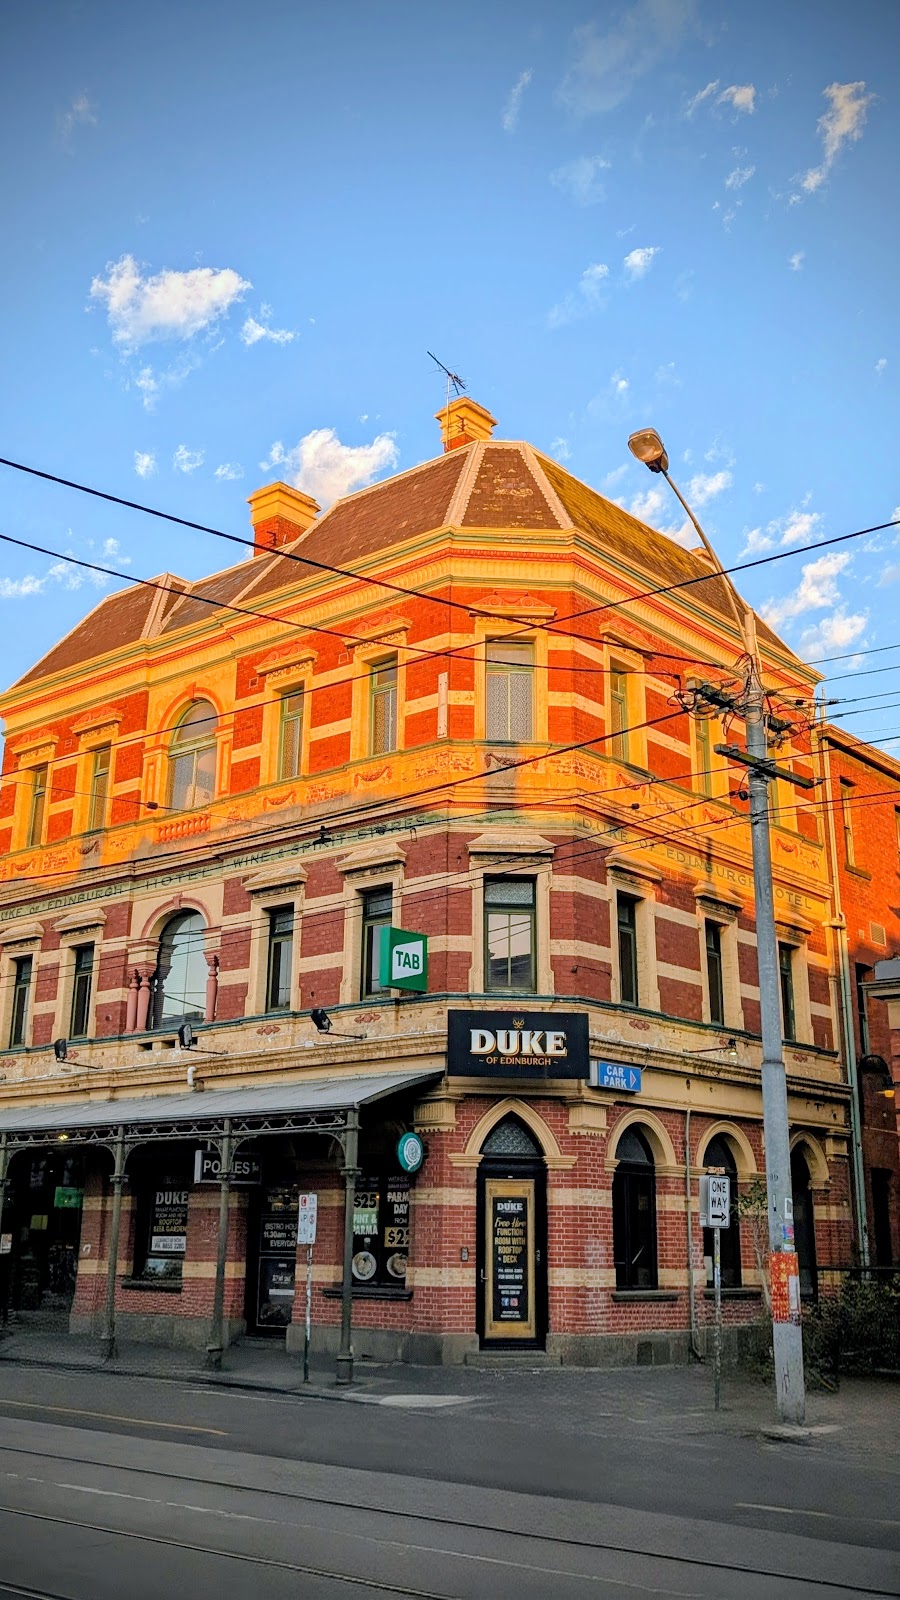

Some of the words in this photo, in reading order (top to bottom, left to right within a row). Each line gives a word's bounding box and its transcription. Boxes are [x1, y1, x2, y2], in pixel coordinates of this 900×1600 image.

[234, 849, 271, 868] WINE
[47, 885, 123, 910] EDINBURGH
[145, 868, 213, 890] HOTEL
[775, 887, 812, 910] OTEL
[395, 950, 420, 970] TAB
[469, 1028, 568, 1057] DUKE
[486, 1057, 498, 1065] OF
[500, 1057, 551, 1066] EDINBURGH
[606, 1065, 625, 1078] CAR
[603, 1076, 627, 1088] PARK
[712, 1181, 727, 1193] ONE
[155, 1191, 188, 1205] DUKE
[353, 1193, 377, 1208] $25
[387, 1192, 410, 1202] PARM
[711, 1197, 728, 1209] WAY
[393, 1203, 408, 1214] DAY
[496, 1202, 524, 1211] DUKE
[371, 1213, 378, 1224] &
[264, 1222, 284, 1230] BISTRO
[496, 1228, 524, 1236] FUNCTION
[494, 1237, 511, 1245] ROOM
[511, 1237, 526, 1245] WITH
[497, 1246, 522, 1255] ROOFTOP
[502, 1255, 518, 1263] DECK
